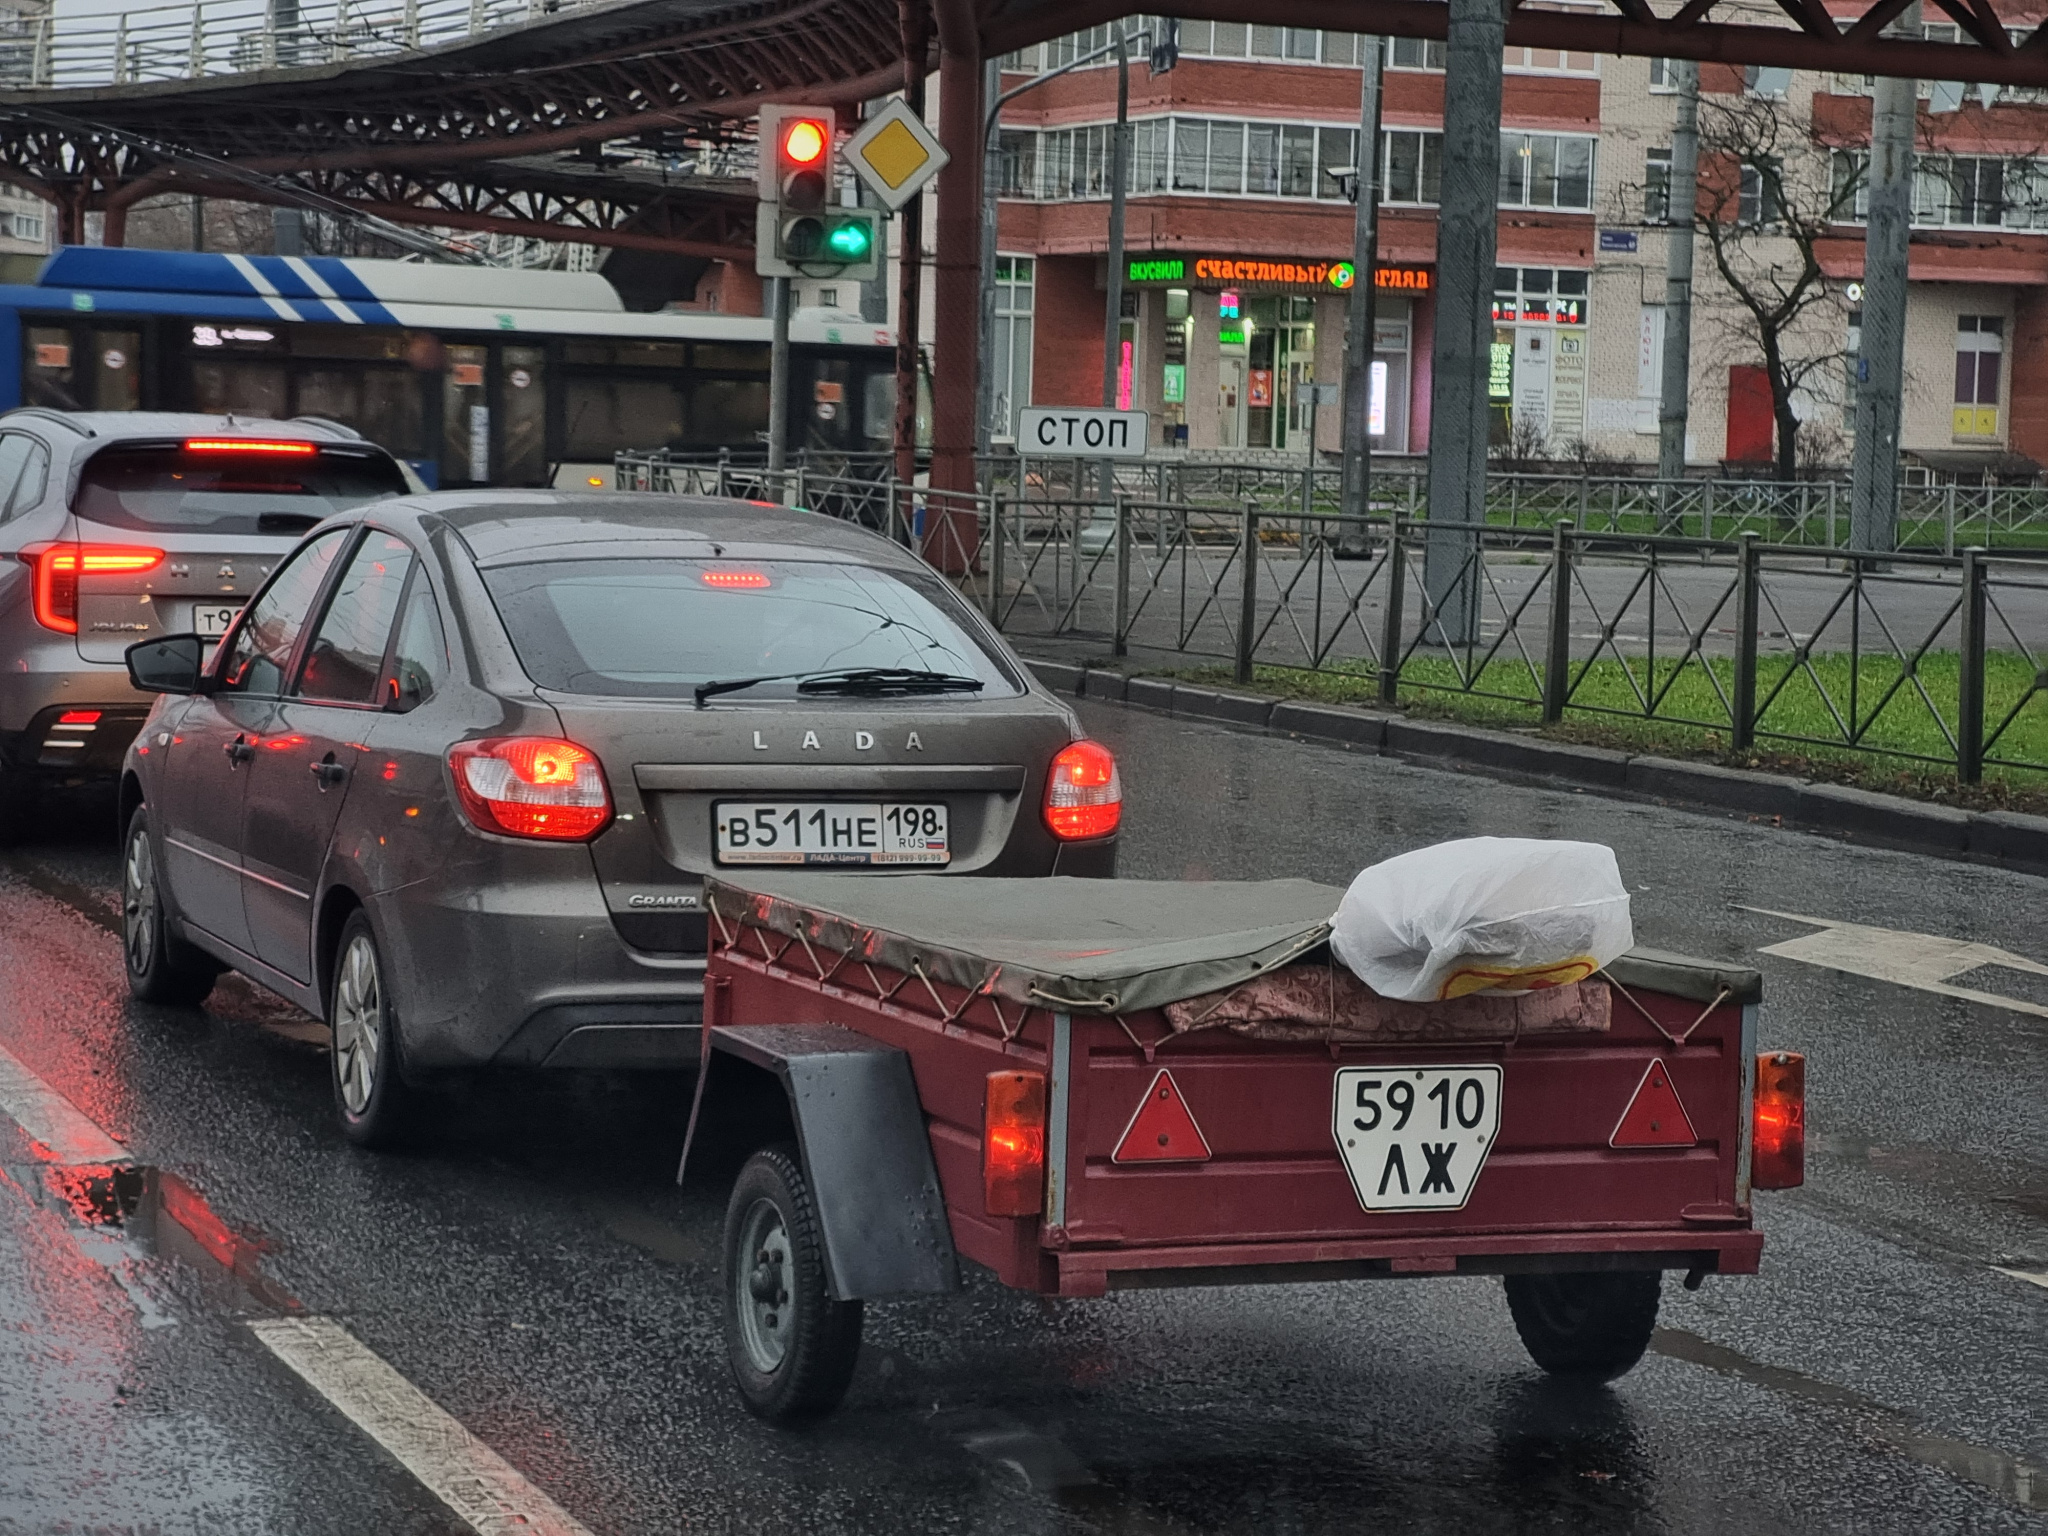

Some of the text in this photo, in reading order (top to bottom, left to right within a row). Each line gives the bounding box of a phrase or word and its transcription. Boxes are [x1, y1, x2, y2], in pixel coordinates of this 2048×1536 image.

[1130, 259, 1184, 281] ВКУСВИЛЛ
[1037, 416, 1128, 448] СТОП
[752, 730, 923, 751] LADA
[886, 806, 938, 837] 198
[899, 837, 925, 849] RUS
[628, 894, 697, 907] GRANTA
[1377, 1142, 1458, 1196] ЛЖ
